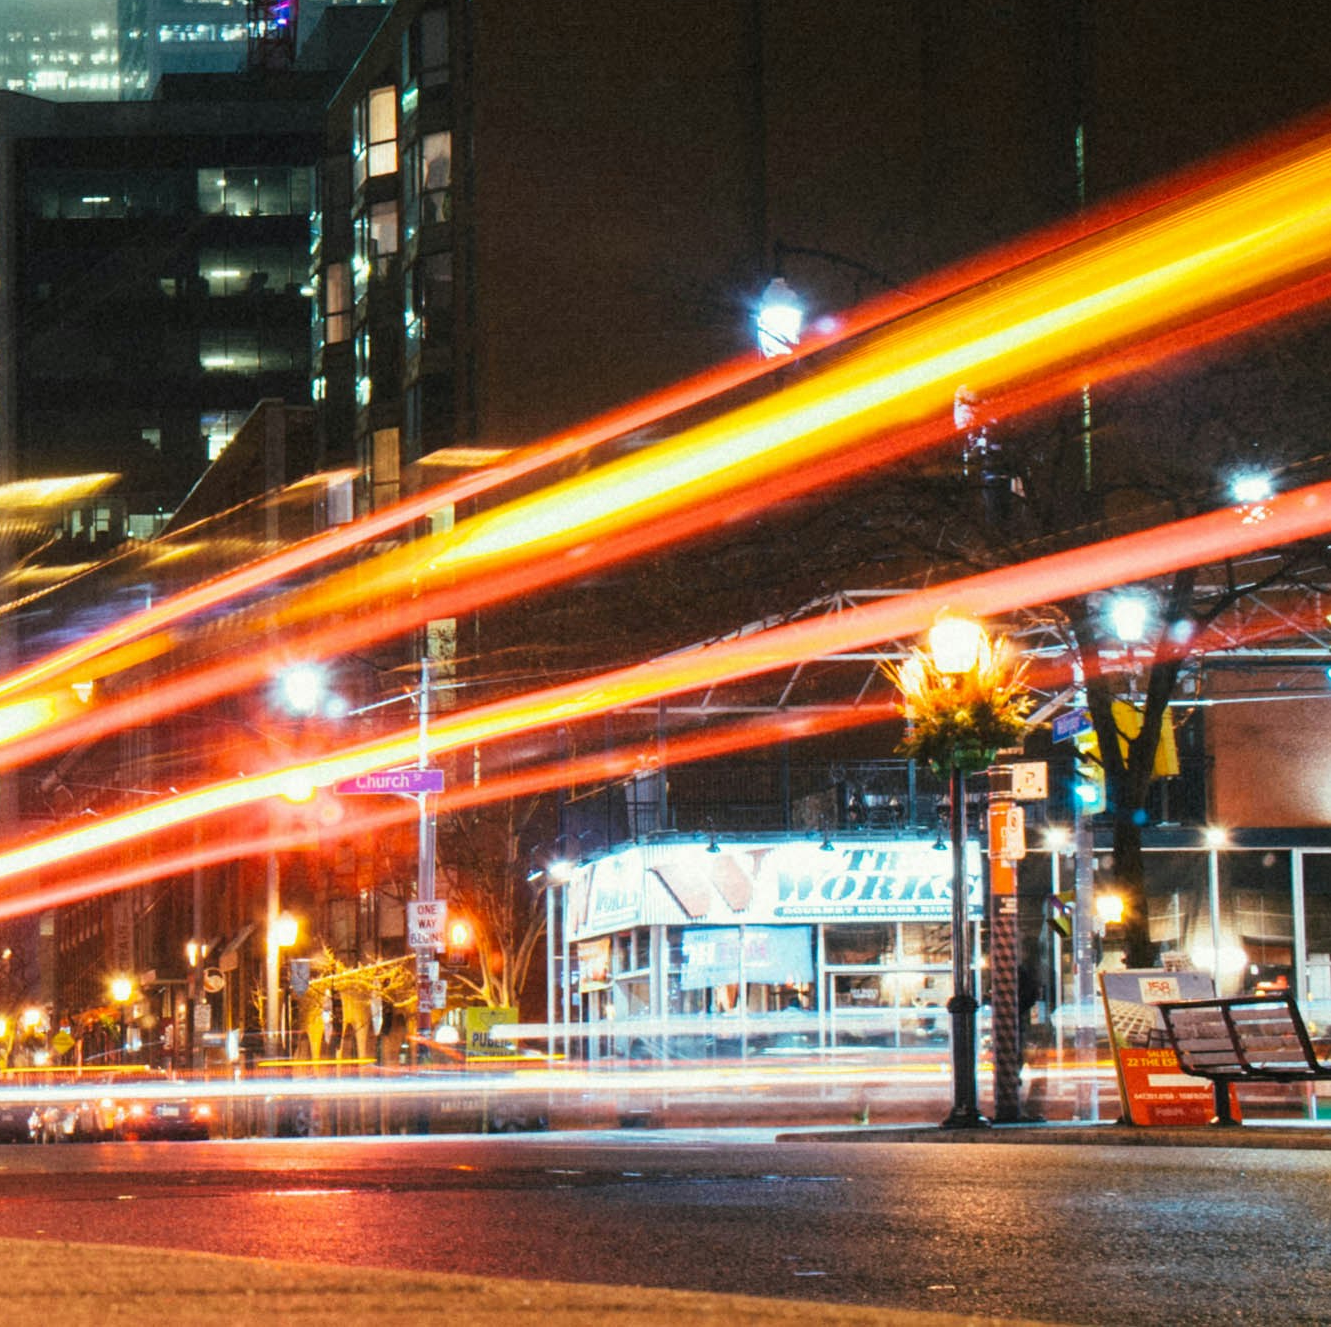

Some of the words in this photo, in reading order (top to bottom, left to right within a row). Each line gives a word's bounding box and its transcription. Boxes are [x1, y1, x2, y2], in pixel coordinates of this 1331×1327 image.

[355, 774, 410, 789] Church
[417, 905, 437, 915] ONE
[857, 906, 917, 914] BURGER
[920, 906, 974, 914] BISTO
[418, 920, 437, 929] WAY
[410, 932, 445, 945] BEGINS
[1127, 1058, 1138, 1067] 22
[1141, 1058, 1159, 1067] THE
